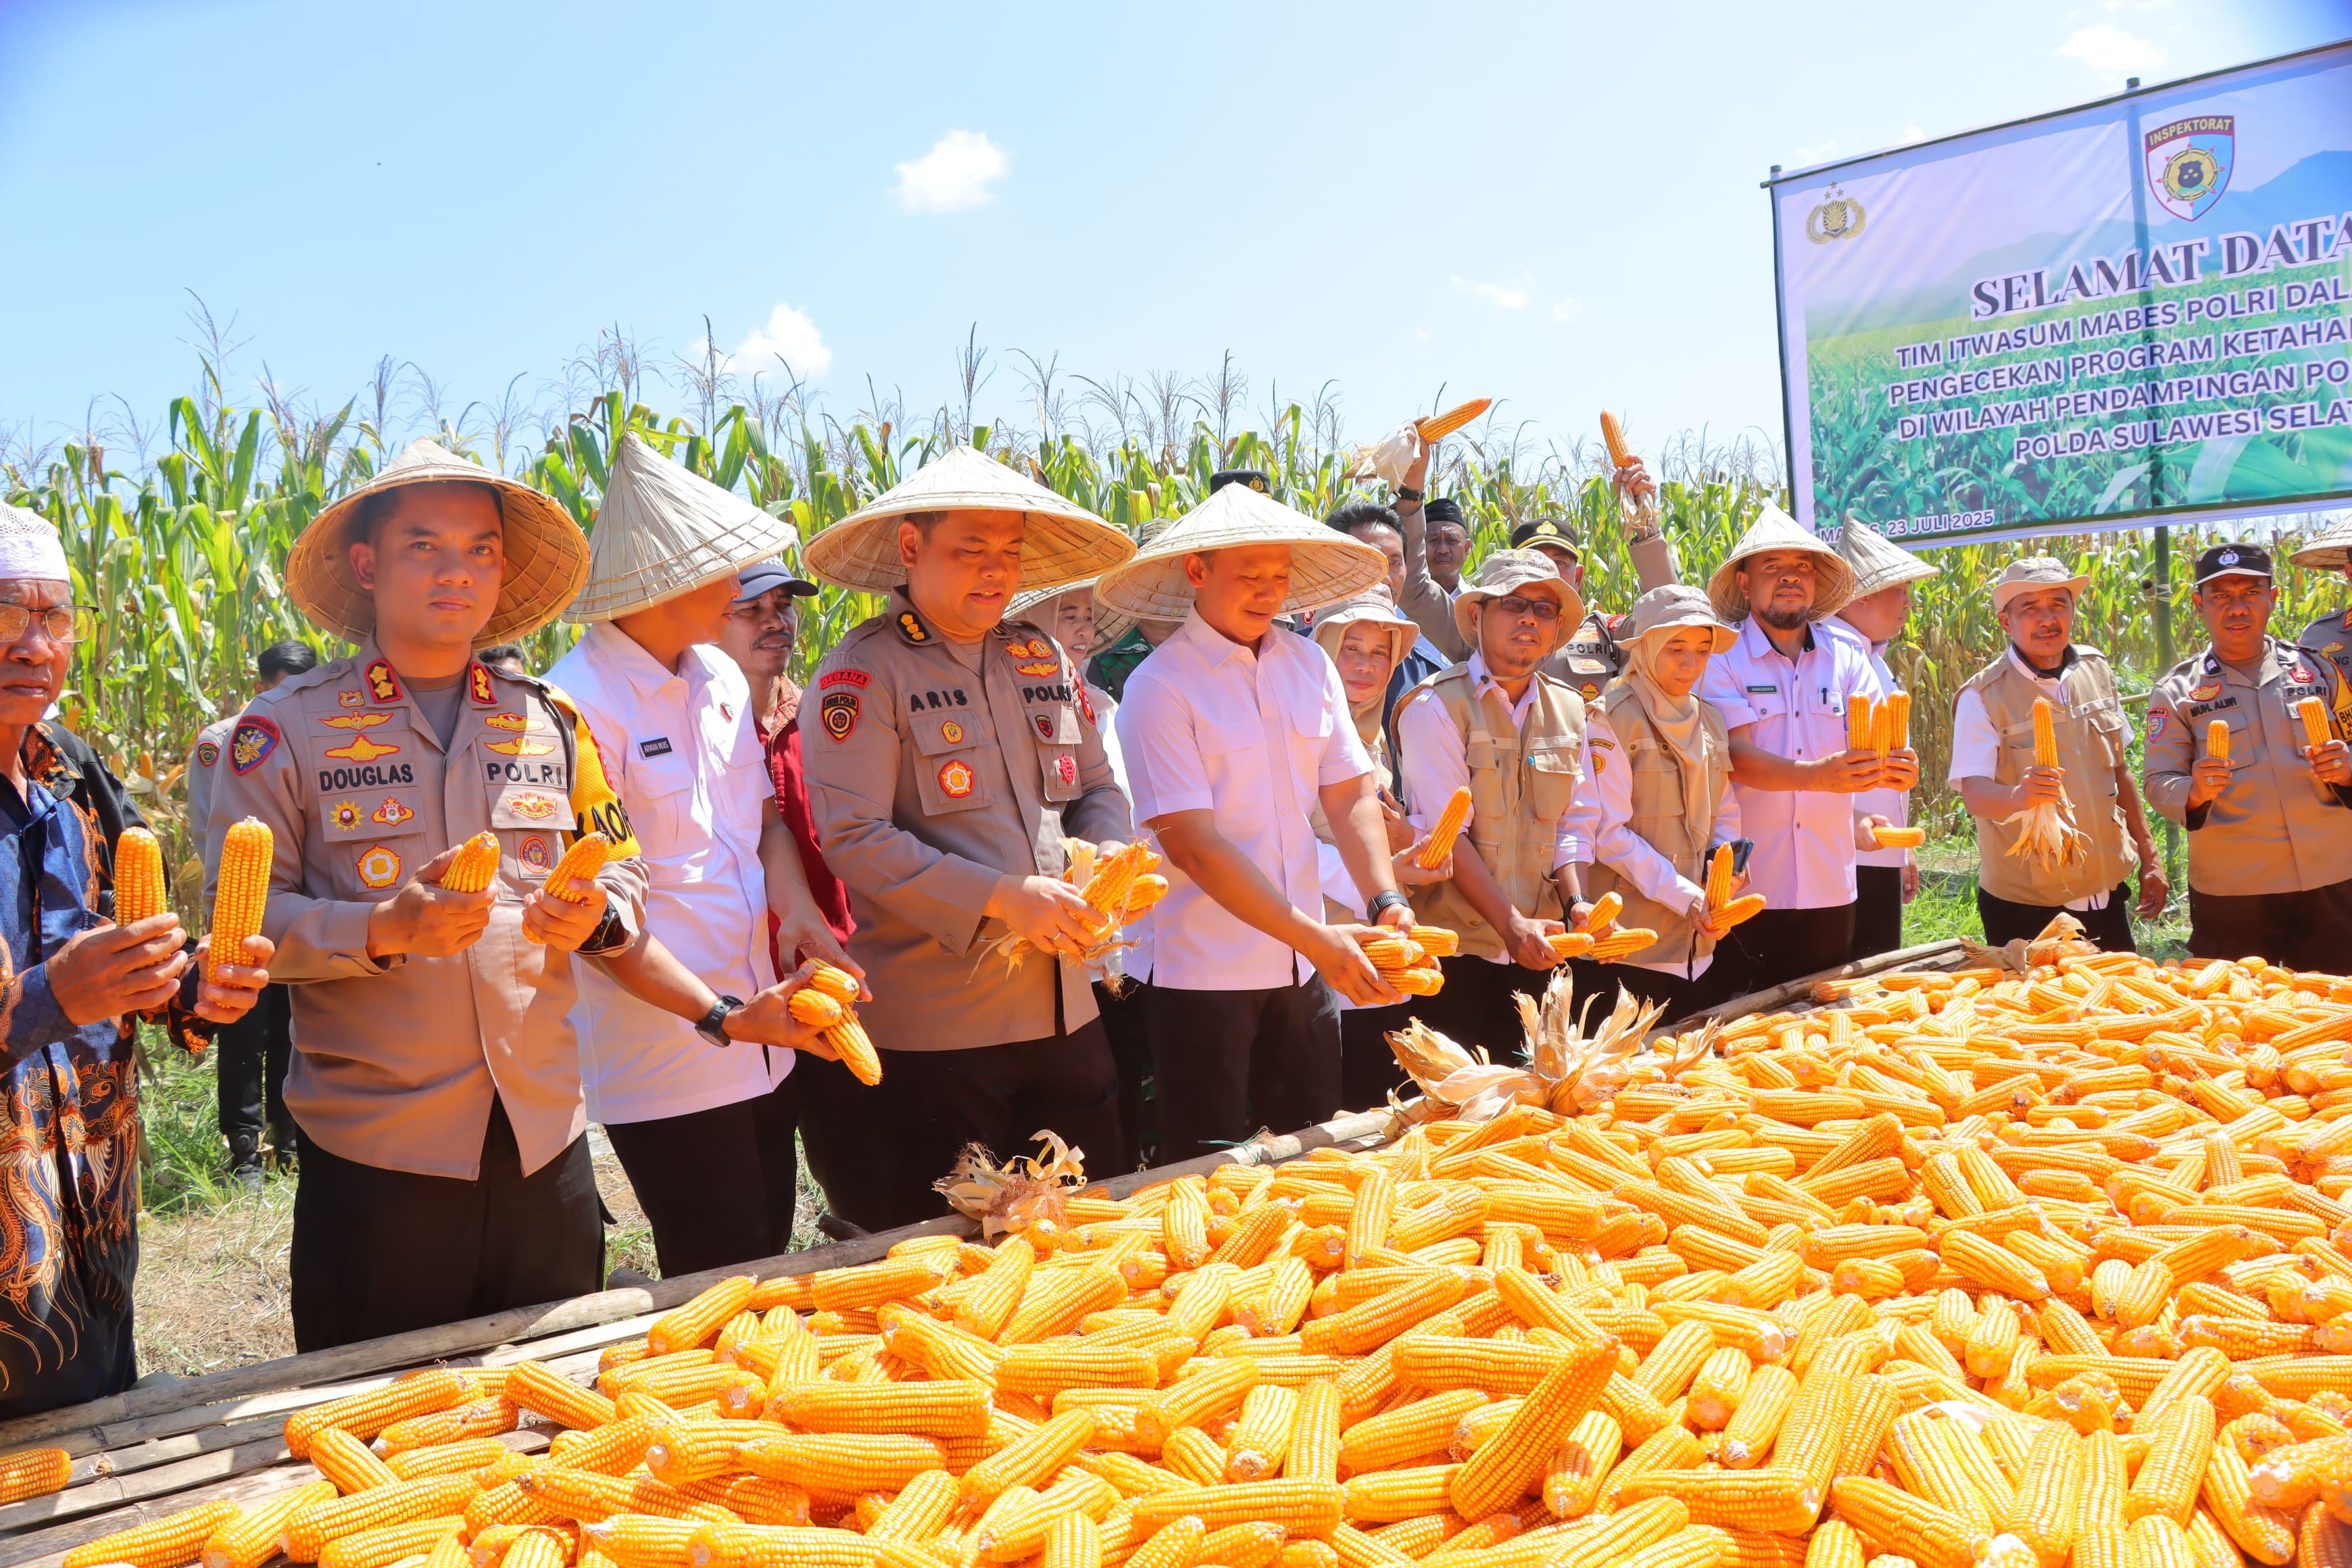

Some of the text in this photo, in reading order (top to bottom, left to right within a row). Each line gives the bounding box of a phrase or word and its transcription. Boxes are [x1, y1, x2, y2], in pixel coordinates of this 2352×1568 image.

[2149, 118, 2232, 146] INSPEKTORAT
[1973, 241, 2205, 318] SELAMAT
[1896, 278, 2352, 368] TIM ITWASUM MABES POLRI DAL
[1890, 318, 2352, 404] PENGECEKAN PROGRAM KETAHA
[1899, 416, 1925, 439] DI
[1932, 399, 2047, 435] WILAYAH
[2055, 366, 2295, 418] PENDAMPINGAN
[2016, 399, 2352, 461] POLDA SULAWESI SELA
[1821, 510, 1994, 542] MAS, 23 JULI 2025
[1567, 643, 1607, 655] POLRI
[822, 672, 864, 685] GEGANA
[2286, 685, 2327, 697] POLRI
[910, 688, 968, 712] ARIS
[1023, 685, 1072, 704] POLRI
[2338, 707, 2352, 723] BH
[319, 763, 414, 791] DOUGLAS
[486, 762, 562, 785] POLRI
